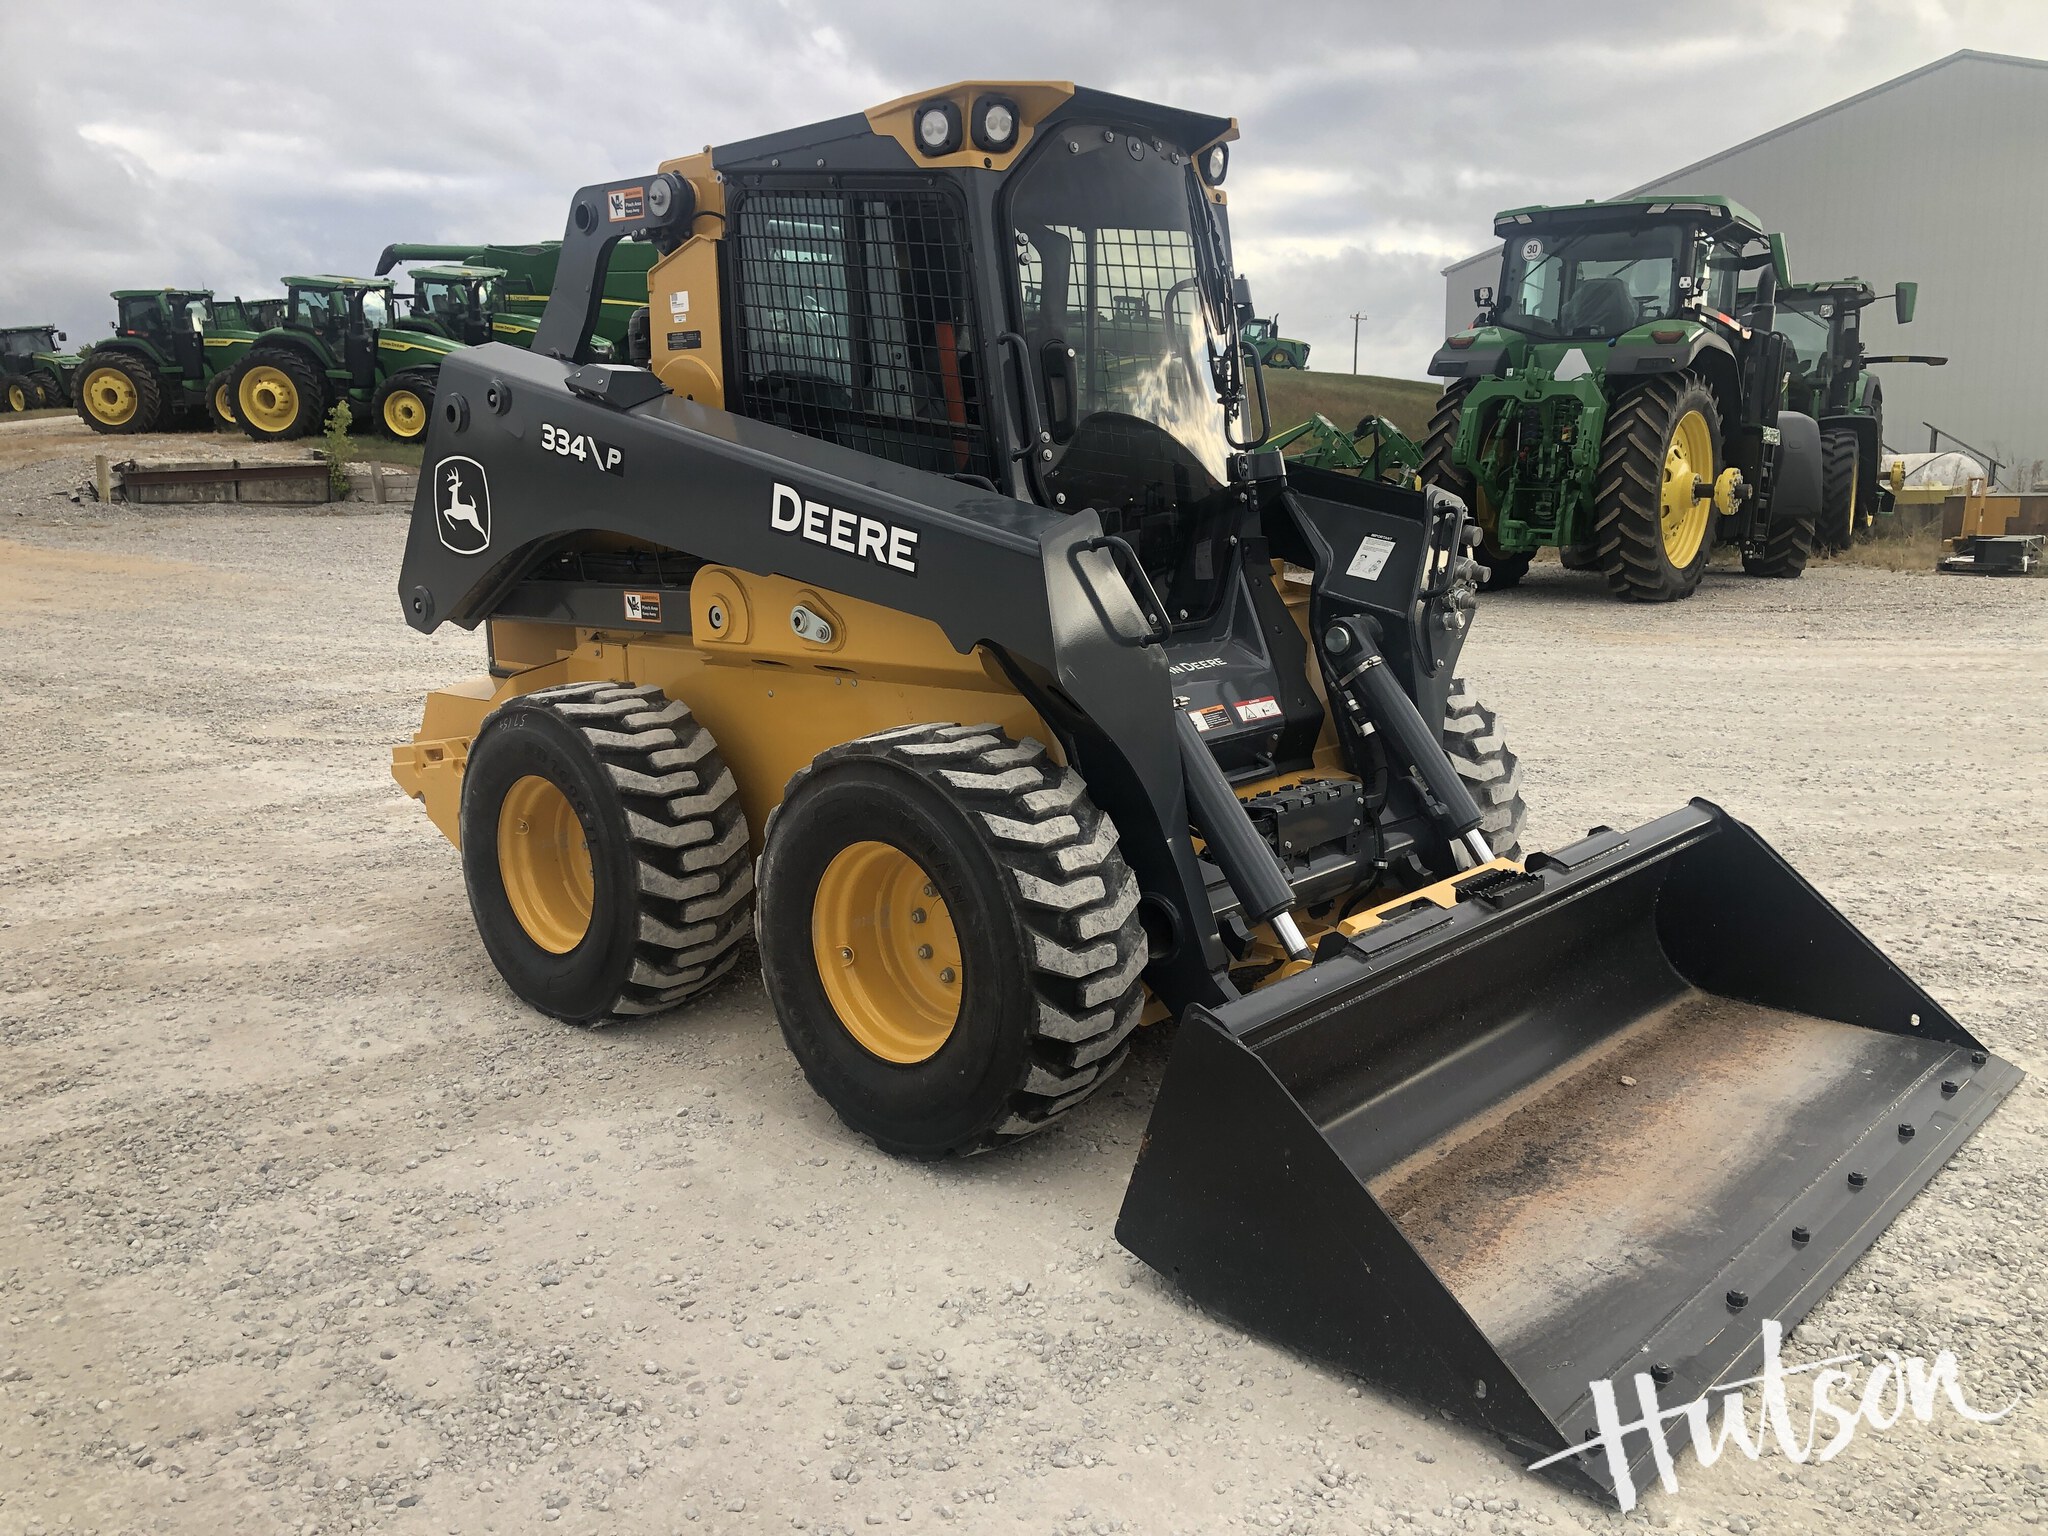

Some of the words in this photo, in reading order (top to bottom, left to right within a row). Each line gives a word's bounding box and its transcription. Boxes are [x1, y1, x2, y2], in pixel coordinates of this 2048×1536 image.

[1526, 244, 1538, 254] 30
[770, 482, 919, 573] DEERE
[1179, 657, 1228, 672] DEERE
